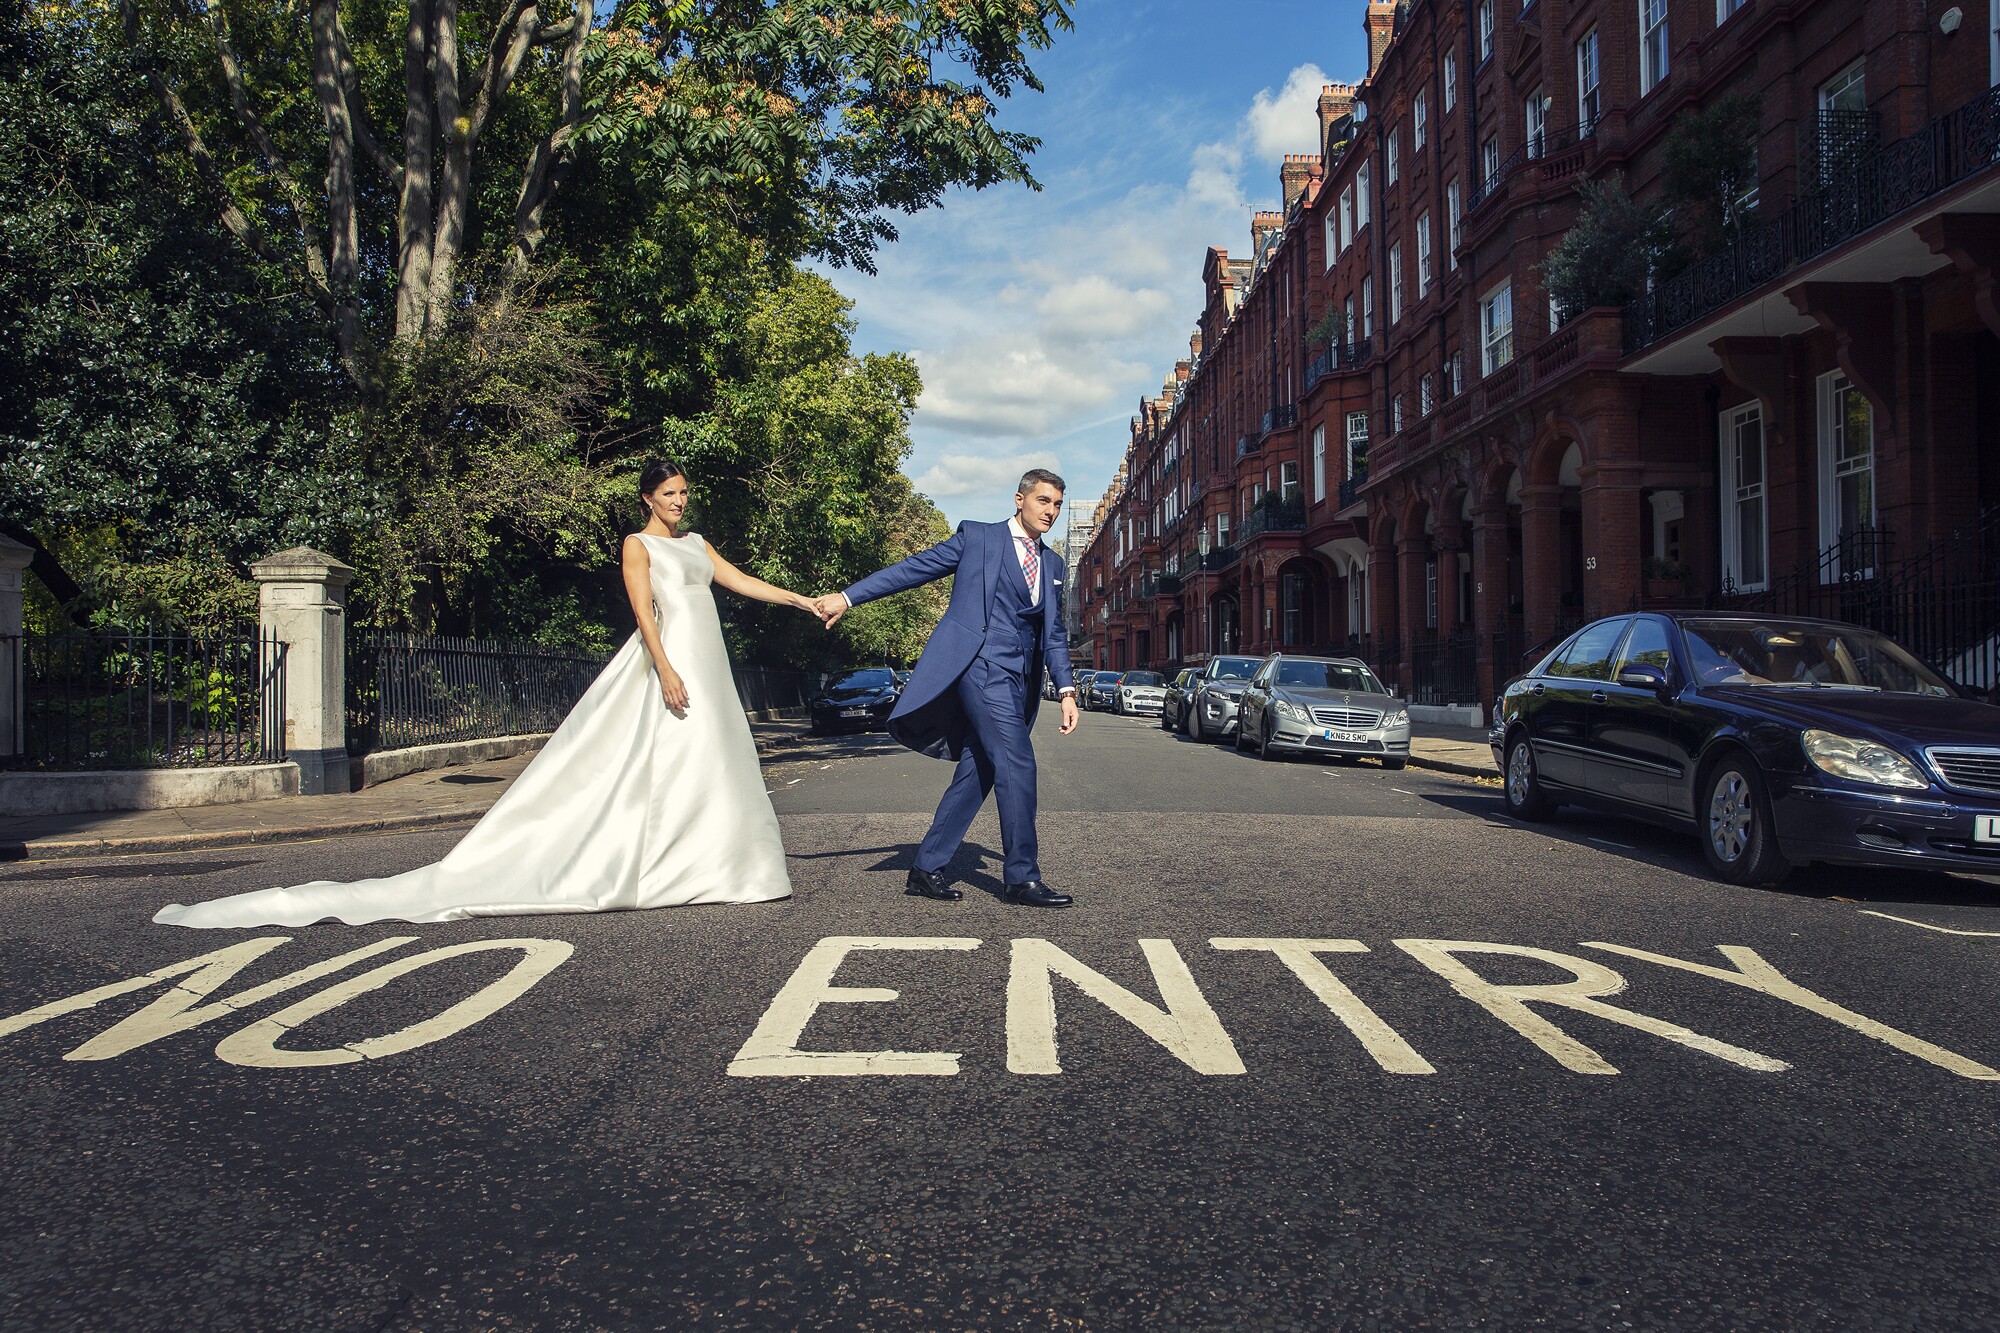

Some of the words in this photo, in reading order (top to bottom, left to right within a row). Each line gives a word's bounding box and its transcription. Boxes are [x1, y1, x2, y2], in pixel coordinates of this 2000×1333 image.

[1586, 556, 1597, 570] 53
[1330, 731, 1351, 741] KN62
[1352, 733, 1367, 742] SMO
[0, 936, 575, 1068] NO
[726, 935, 2000, 1081] ENTRY
